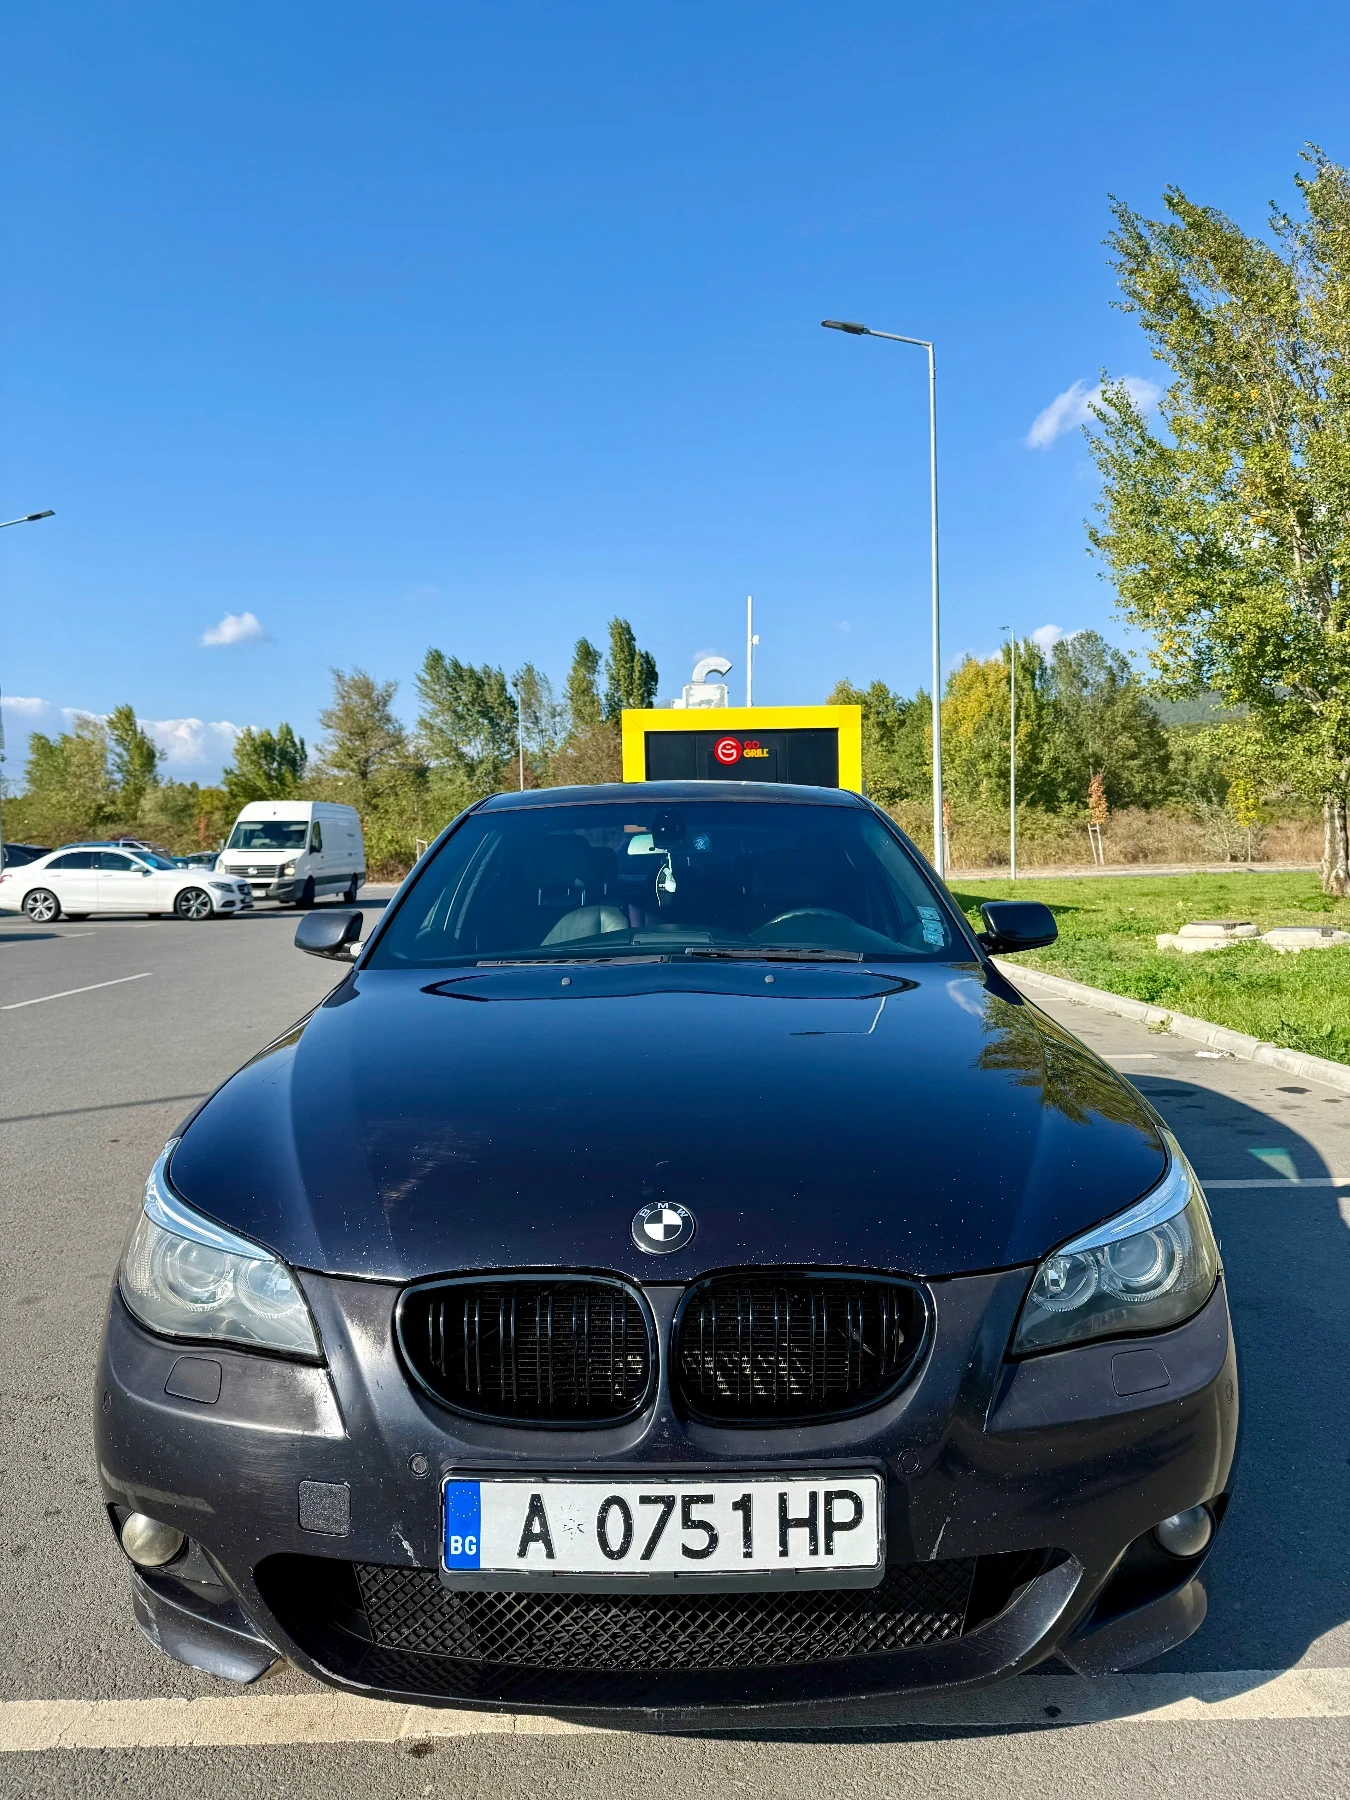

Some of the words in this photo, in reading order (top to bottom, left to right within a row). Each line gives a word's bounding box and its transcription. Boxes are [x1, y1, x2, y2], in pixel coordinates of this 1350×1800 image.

[743, 741, 760, 749] GO
[743, 748, 769, 758] GRILL
[639, 1202, 689, 1218] BMW
[516, 1493, 556, 1560] A
[597, 1493, 753, 1561] 0751
[777, 1489, 864, 1557] HP
[450, 1535, 477, 1555] BG
